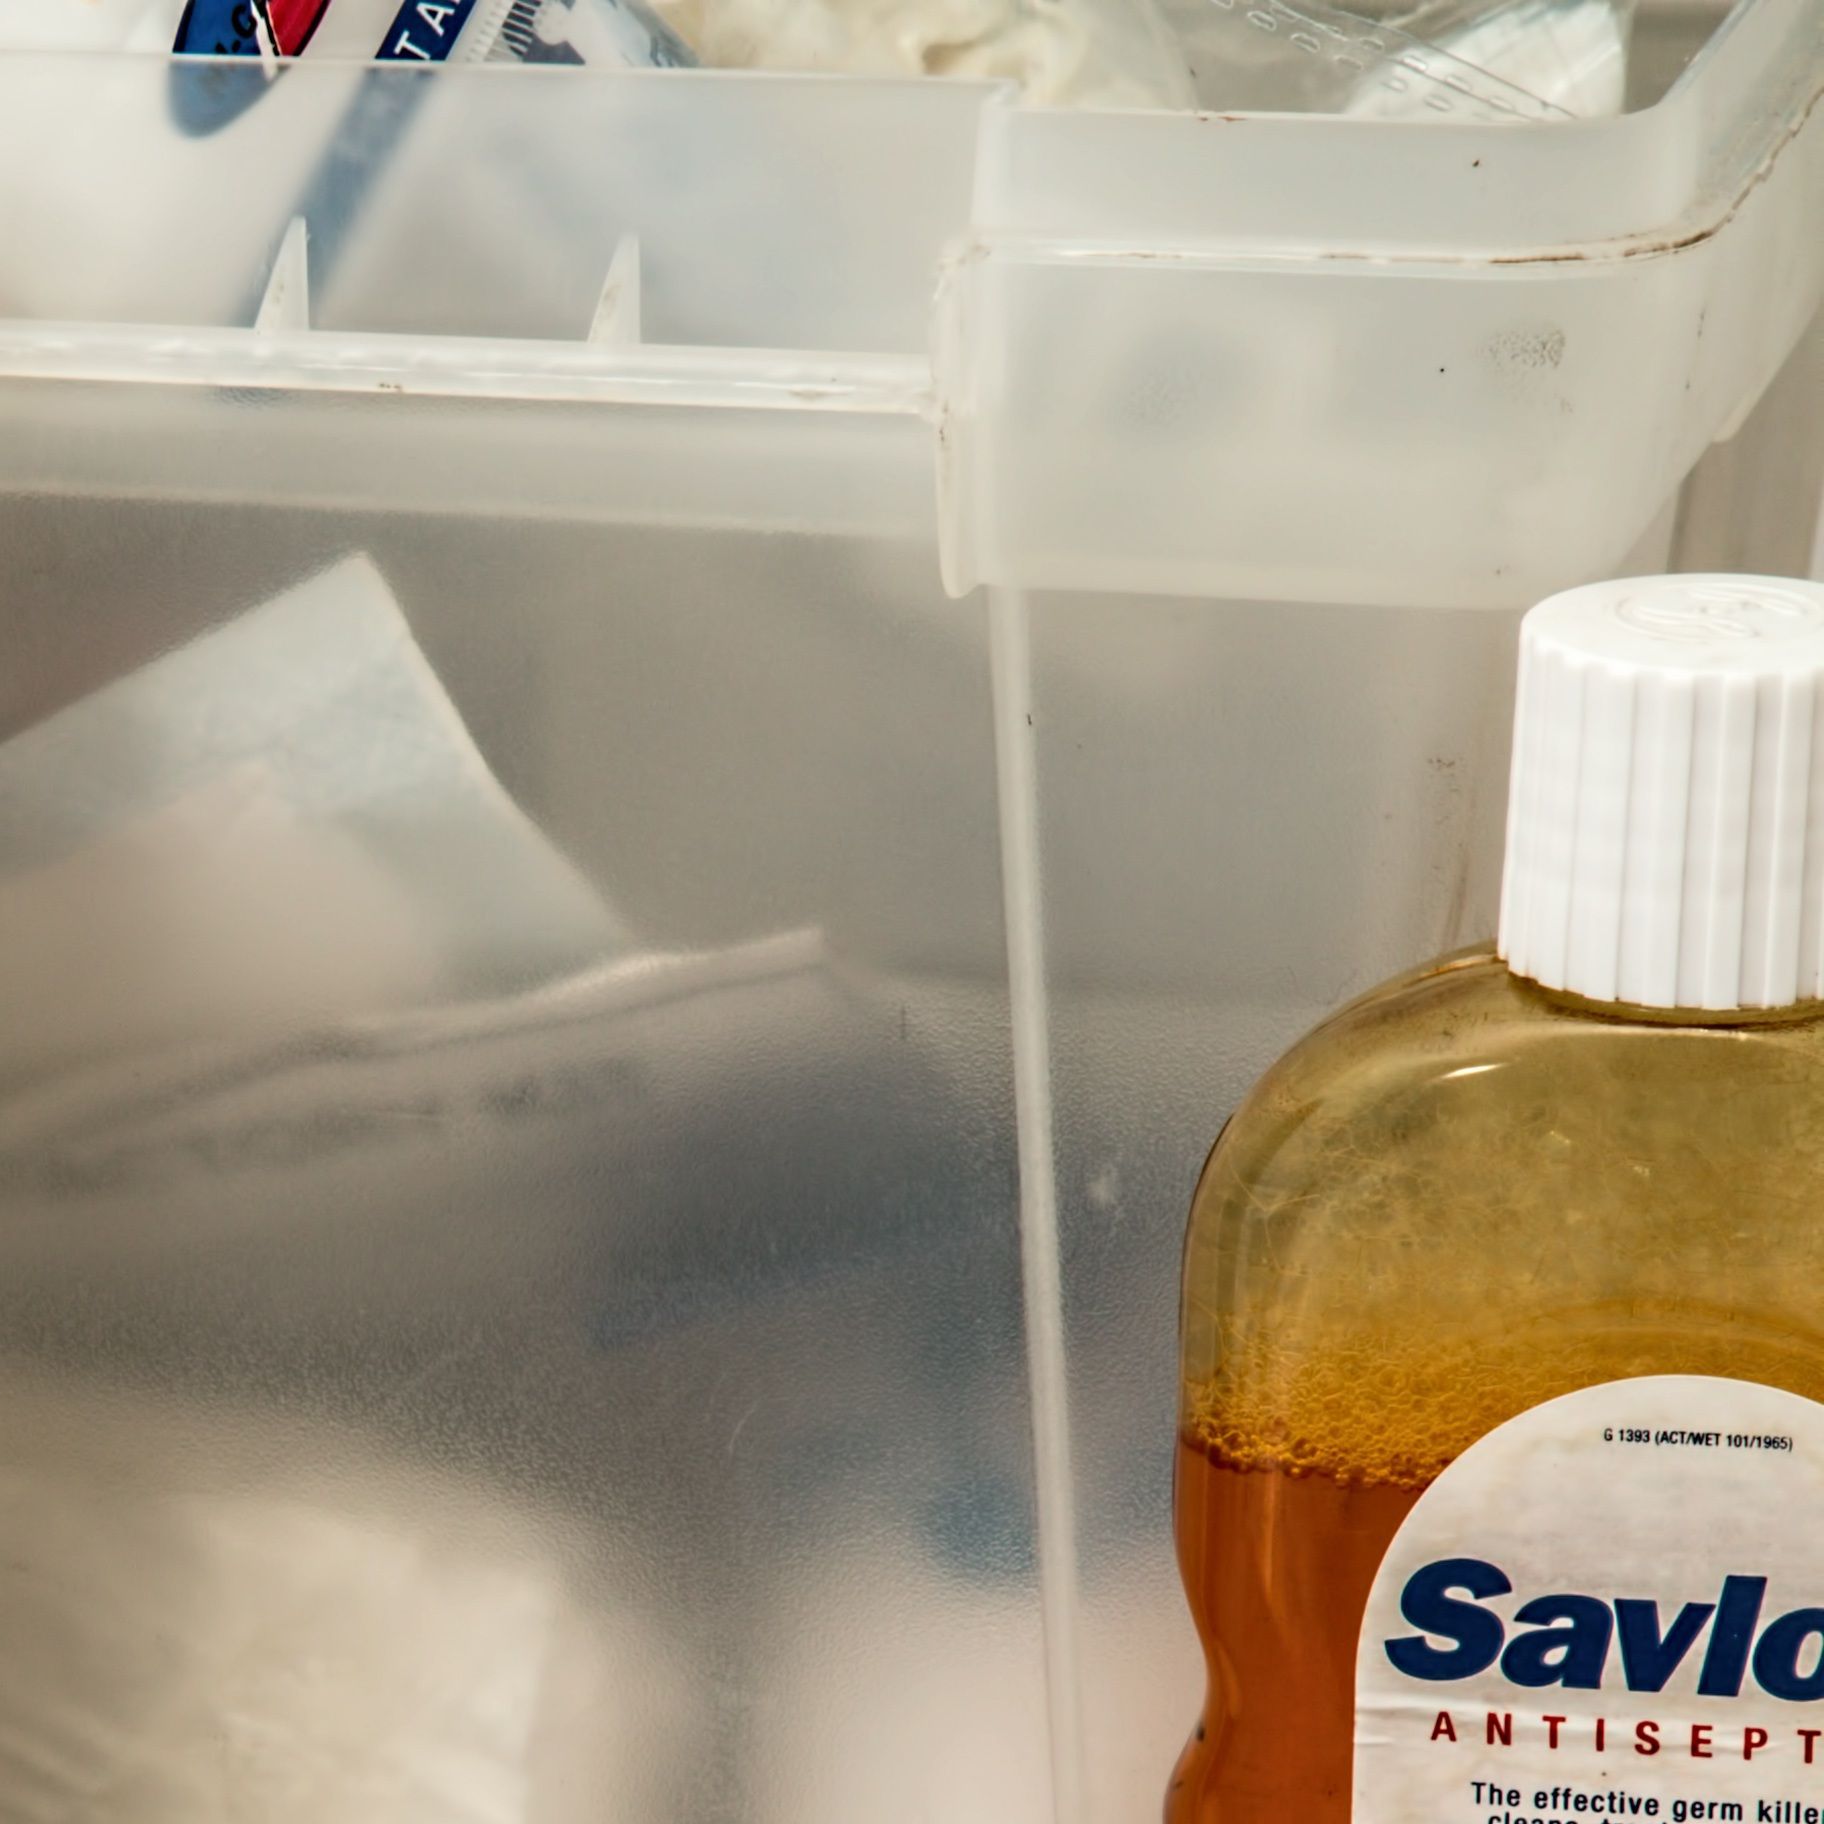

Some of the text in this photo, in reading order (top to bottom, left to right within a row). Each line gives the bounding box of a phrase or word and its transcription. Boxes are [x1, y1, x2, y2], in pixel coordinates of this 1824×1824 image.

[1602, 1427, 1615, 1444] G
[1617, 1428, 1652, 1445] 1393
[1725, 1433, 1794, 1453] 101/1965)
[1470, 1781, 1522, 1808] The
[1533, 1787, 1661, 1818] effective
